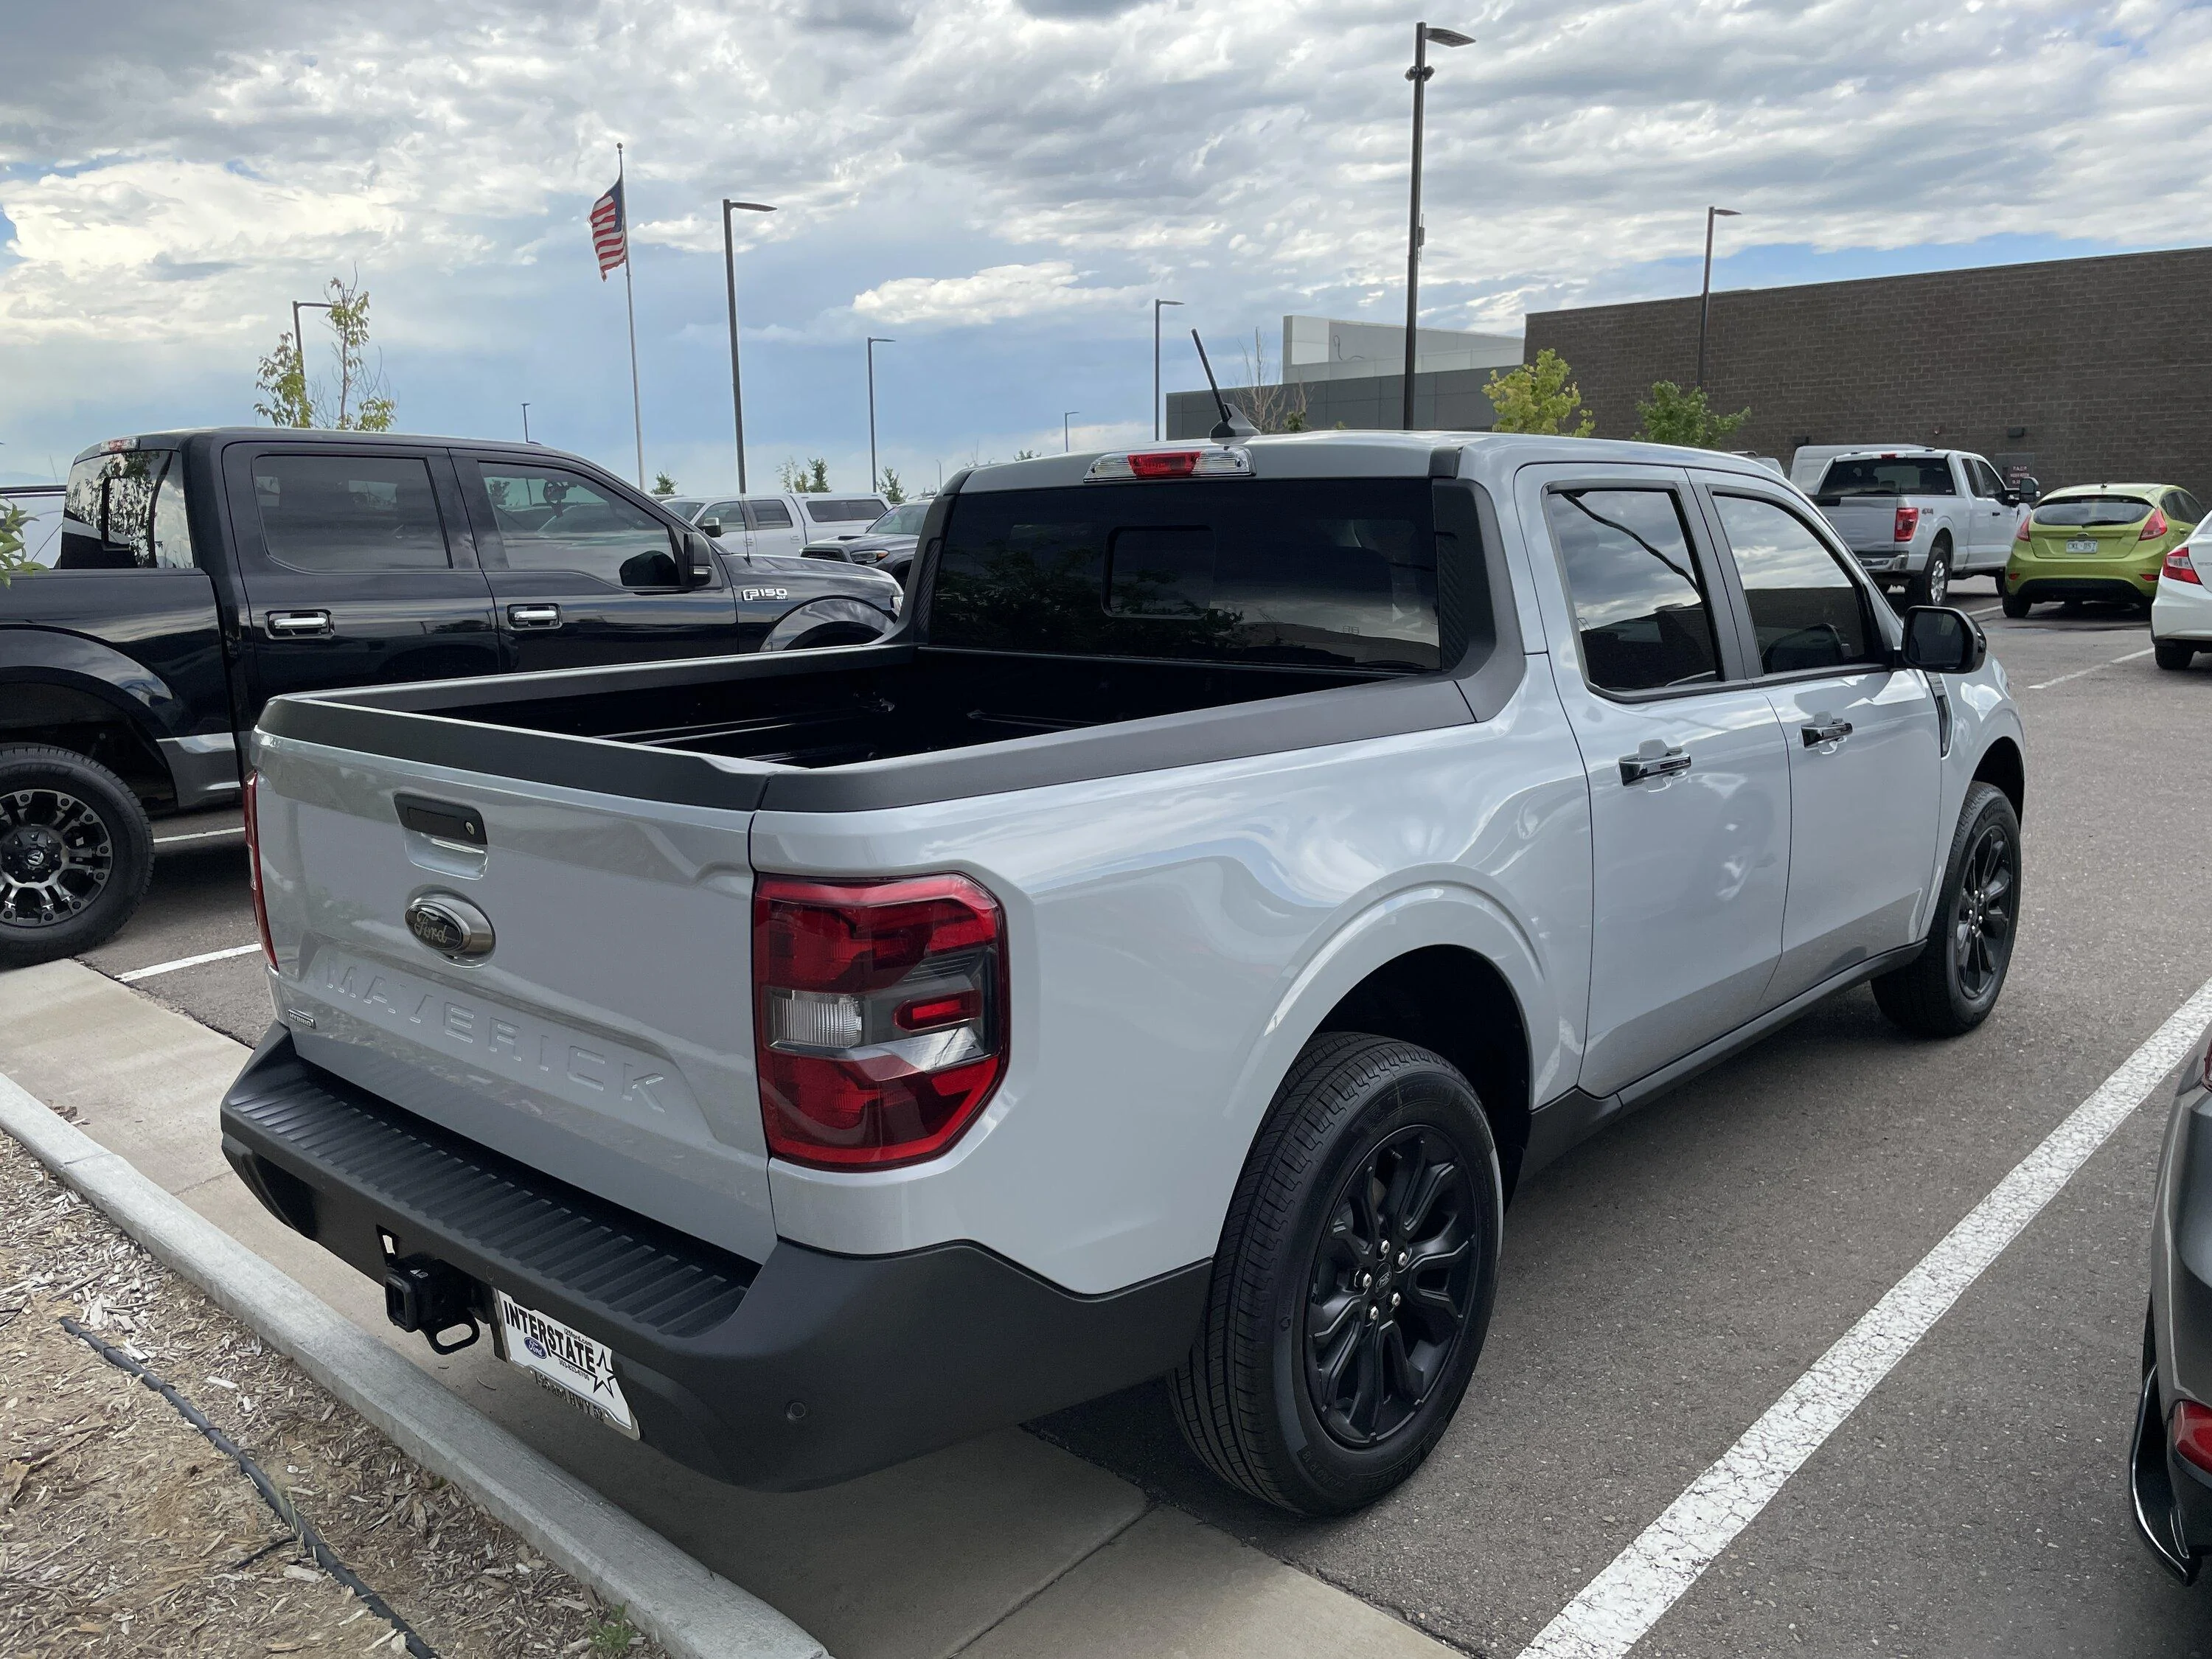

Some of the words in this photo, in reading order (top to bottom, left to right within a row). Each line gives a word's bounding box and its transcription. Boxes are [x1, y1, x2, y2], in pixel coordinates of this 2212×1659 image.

[742, 588, 787, 601] F150
[414, 911, 448, 943] Ford
[289, 1011, 311, 1027] HYBRID
[327, 958, 665, 1113] MAVERICK
[504, 1300, 596, 1374] INTERSTATE
[529, 1339, 543, 1356] Ford
[552, 1385, 567, 1401] and
[568, 1390, 591, 1416] HWY
[593, 1405, 604, 1423] 52
